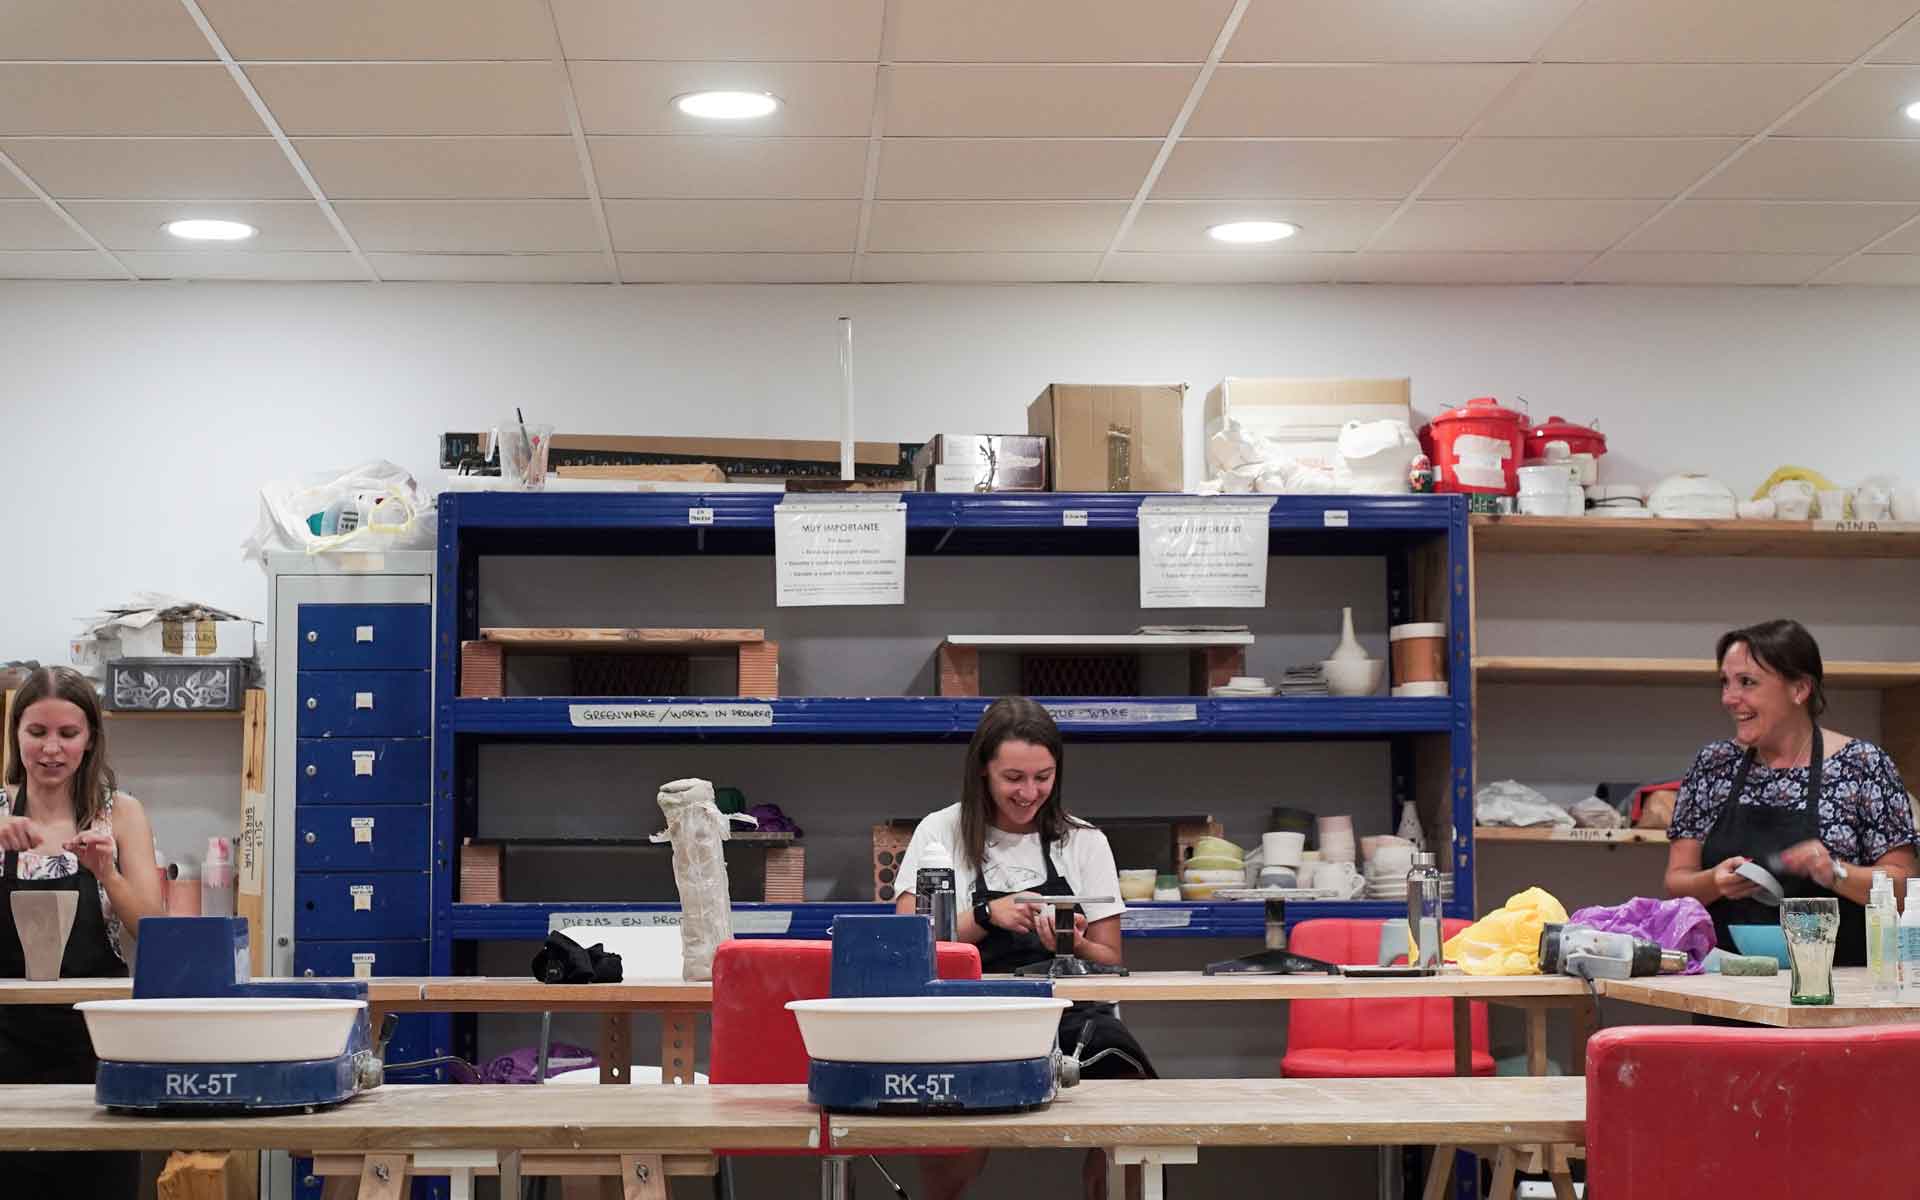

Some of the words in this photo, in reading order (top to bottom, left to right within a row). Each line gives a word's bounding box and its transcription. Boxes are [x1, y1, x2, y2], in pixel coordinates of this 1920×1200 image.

[802, 523, 821, 533] MUY
[823, 522, 880, 532] IMPORTANTE
[562, 918, 611, 926] PIEZAS
[622, 918, 641, 926] EN
[166, 1073, 238, 1095] RK-5T
[885, 1074, 955, 1095] RK-5T
